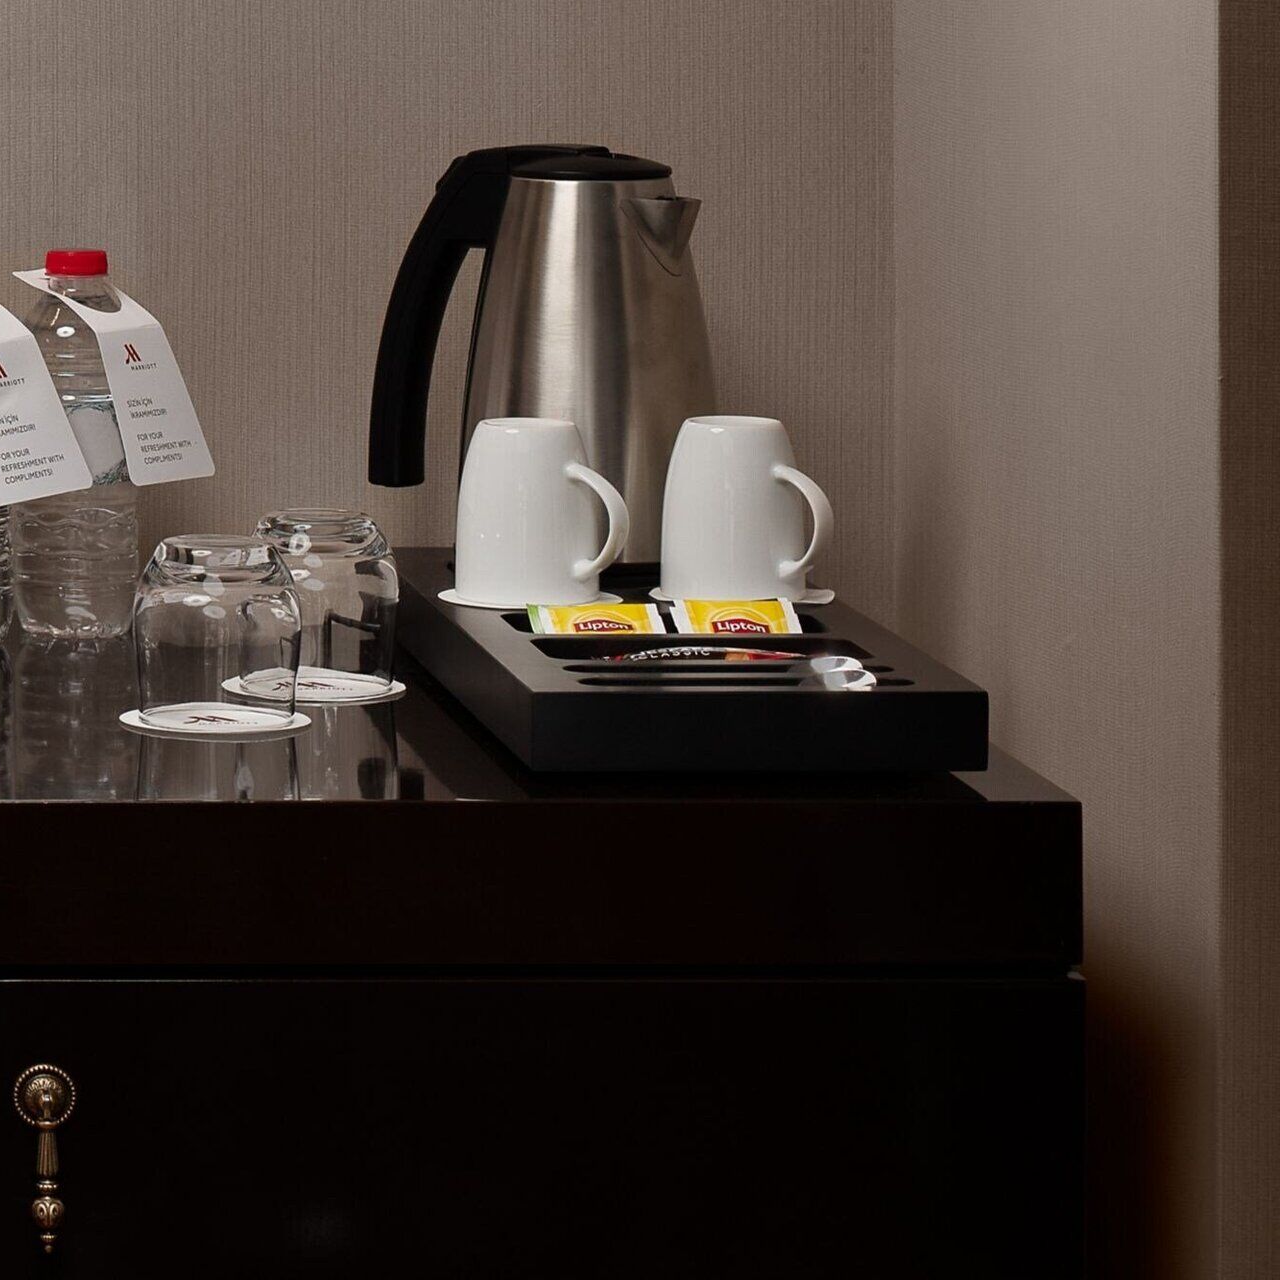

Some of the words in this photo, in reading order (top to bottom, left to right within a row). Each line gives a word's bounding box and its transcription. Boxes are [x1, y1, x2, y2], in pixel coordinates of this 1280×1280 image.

[130, 363, 157, 371] MARRIOTT
[137, 433, 149, 441] FOR
[148, 431, 163, 440] YOUR
[141, 441, 177, 453] REFRESHMENT
[178, 440, 192, 448] WITH
[12, 448, 31, 459] YOUR
[1, 457, 49, 473] REFRESHMENT
[48, 453, 65, 464] WITH
[4, 468, 54, 485] COMPLIMENTS!
[579, 621, 629, 631] Lipton
[717, 621, 766, 633] Lipton
